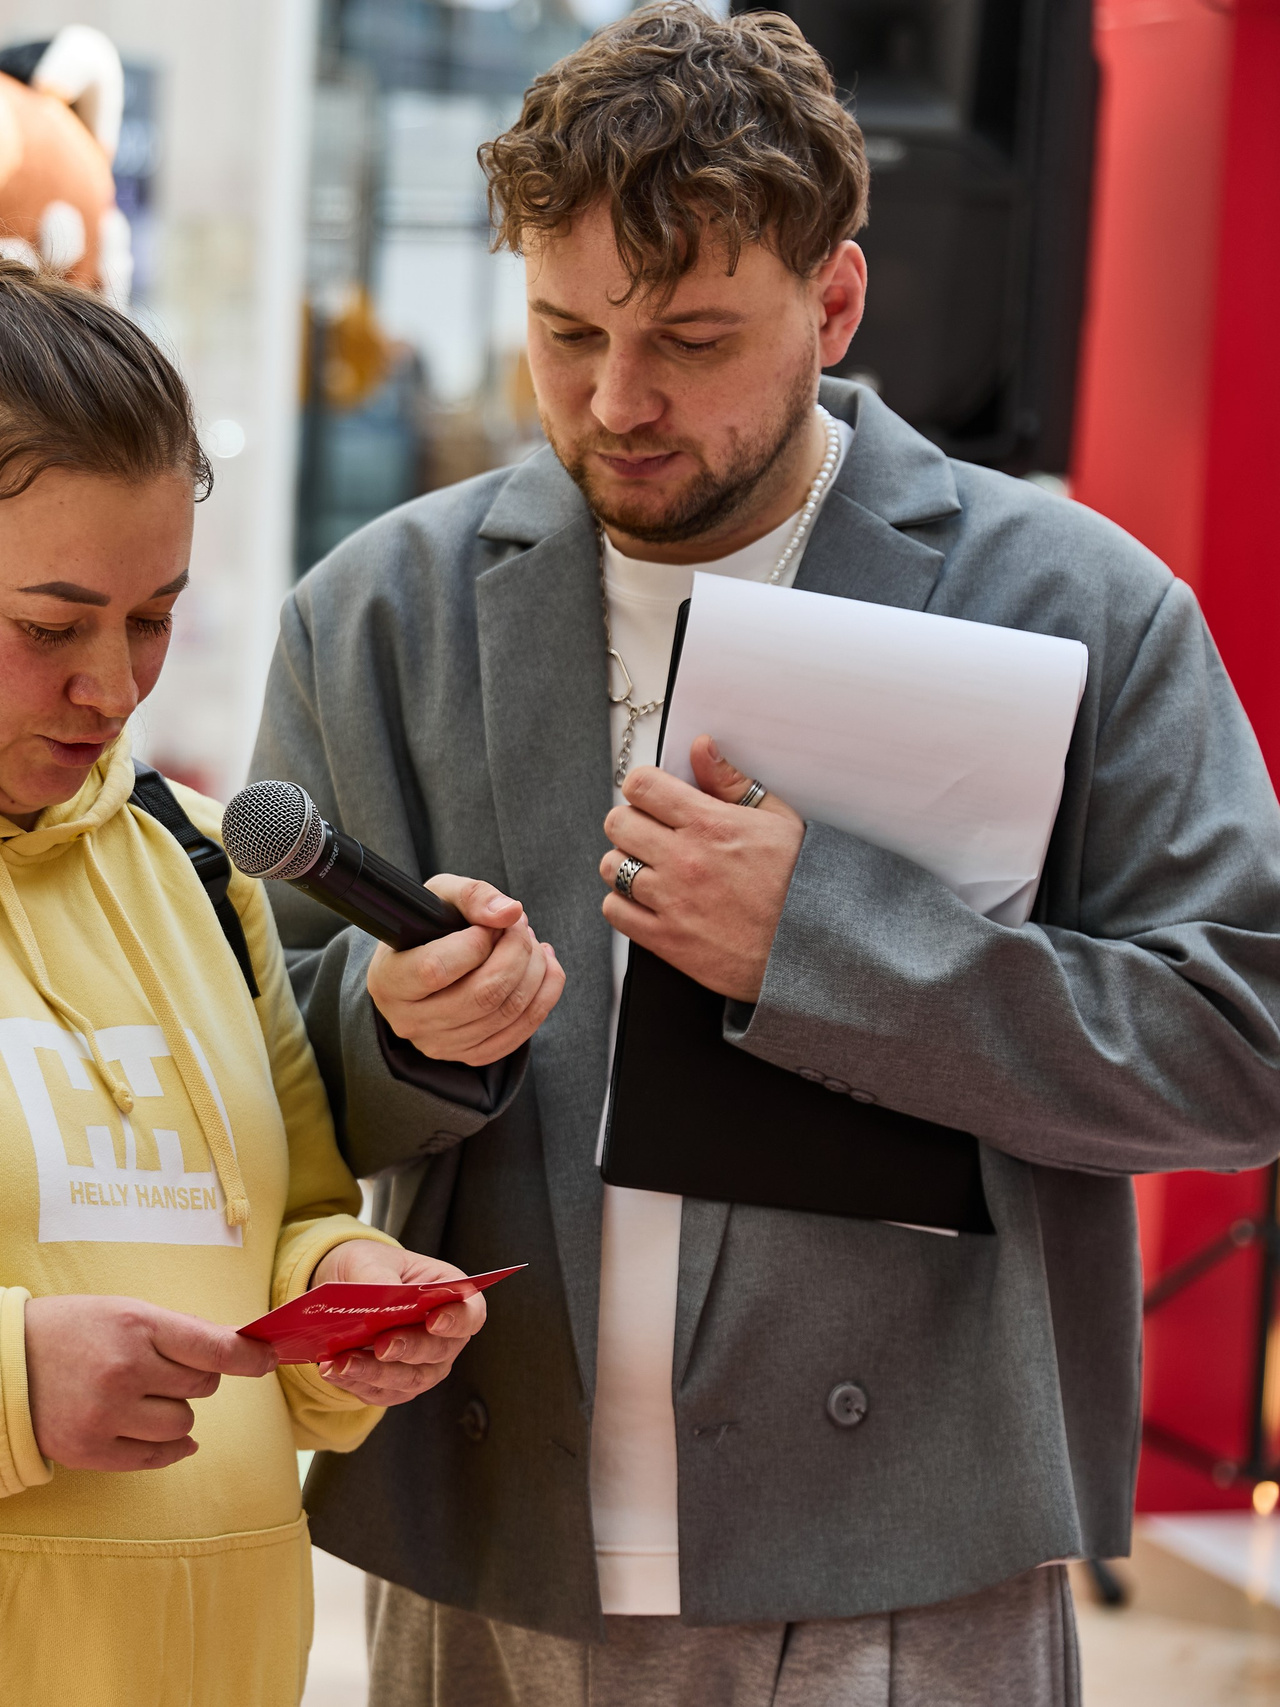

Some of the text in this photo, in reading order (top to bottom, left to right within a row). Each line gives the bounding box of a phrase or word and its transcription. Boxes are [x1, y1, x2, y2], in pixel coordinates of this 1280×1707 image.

[319, 844, 339, 879] SHURE
[69, 1180, 218, 1211] HELLY HANSEN
